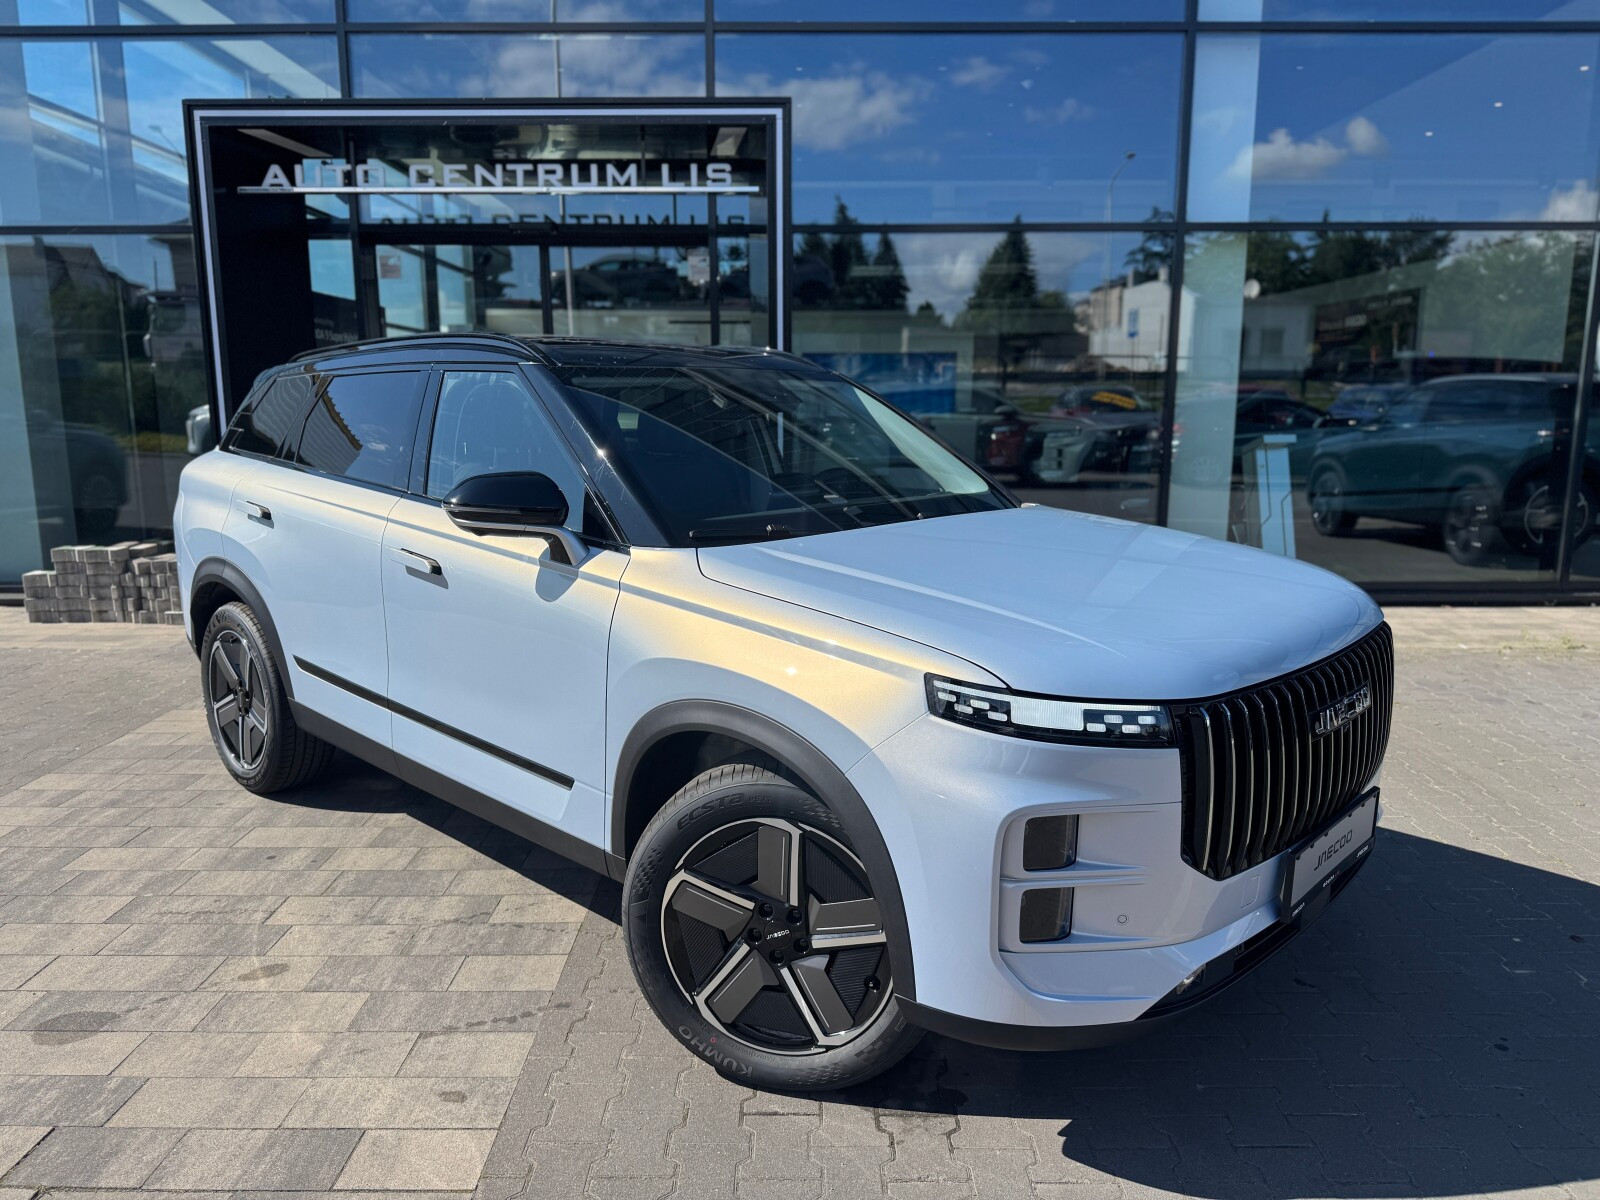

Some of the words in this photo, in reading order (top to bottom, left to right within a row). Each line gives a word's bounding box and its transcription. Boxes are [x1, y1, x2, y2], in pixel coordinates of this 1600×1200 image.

[261, 163, 386, 187] AUTO
[408, 163, 638, 187] CENTRUM
[661, 163, 733, 187] LIS
[678, 1025, 753, 1078] KUMHO
